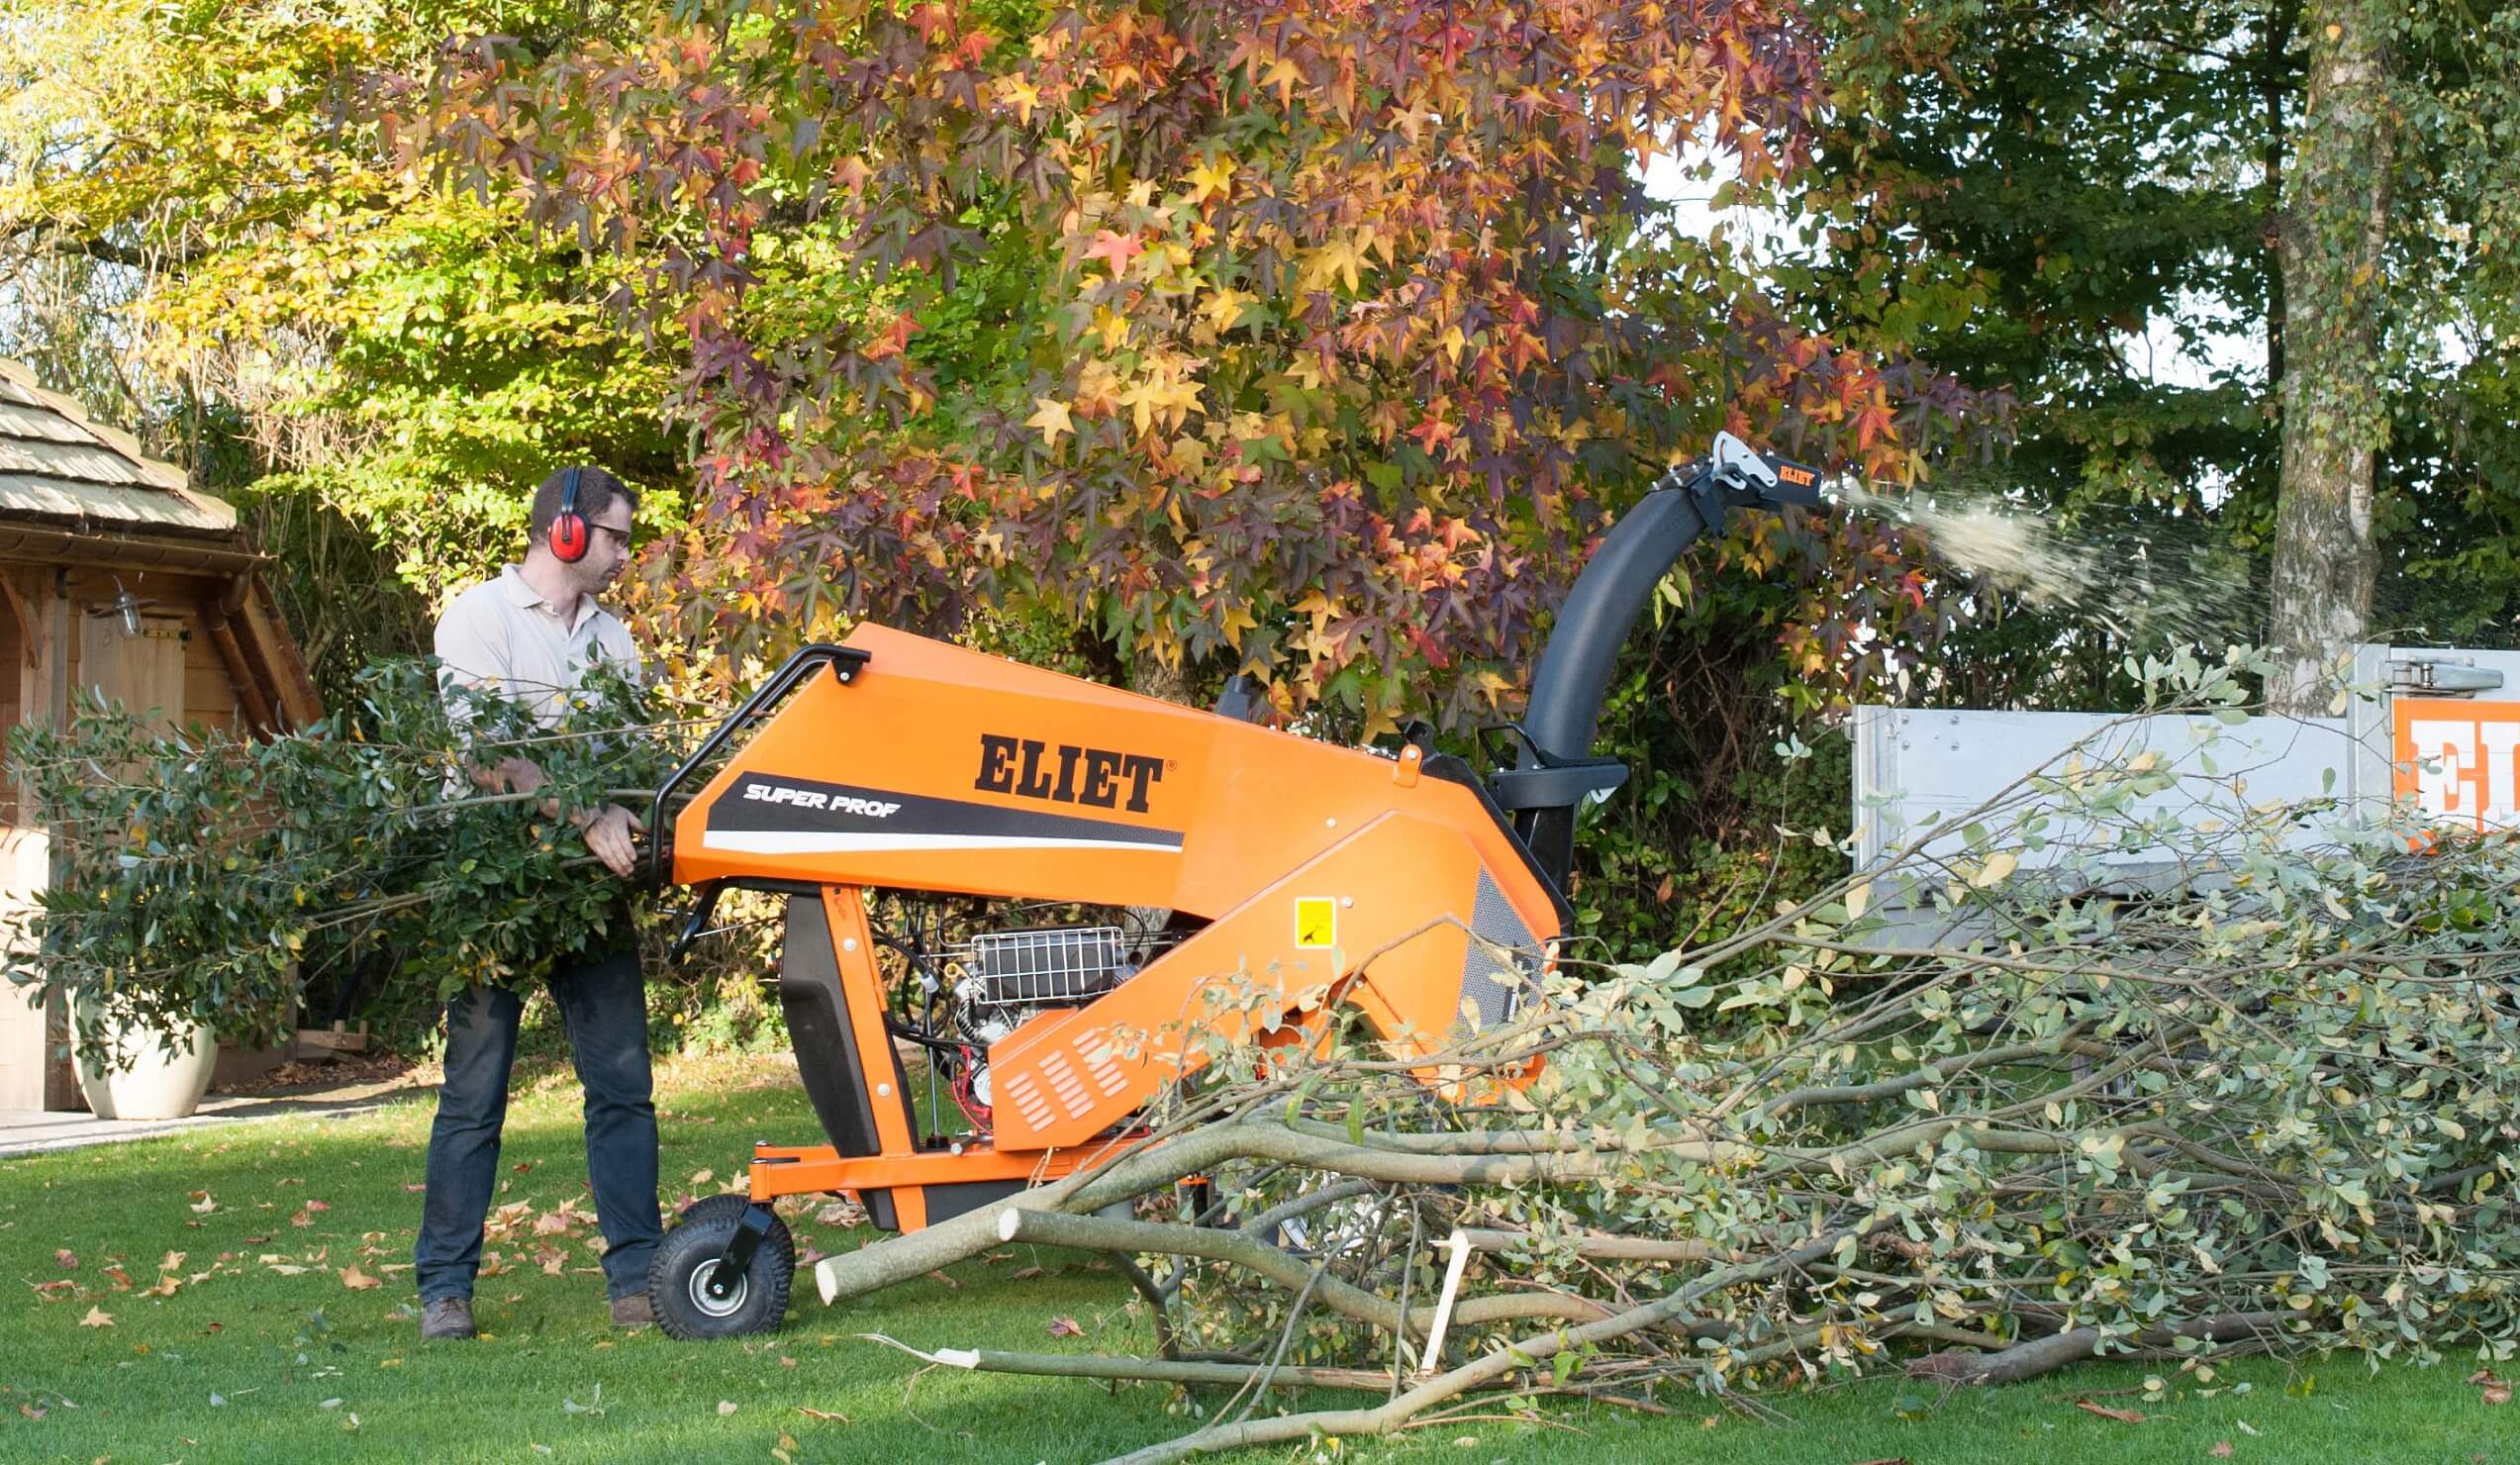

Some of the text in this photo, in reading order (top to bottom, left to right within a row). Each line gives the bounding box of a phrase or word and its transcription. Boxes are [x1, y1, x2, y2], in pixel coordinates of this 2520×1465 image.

[1780, 465, 1815, 486] ELIET
[974, 733, 1164, 814] ELIET
[743, 784, 902, 819] SUPER PROF
